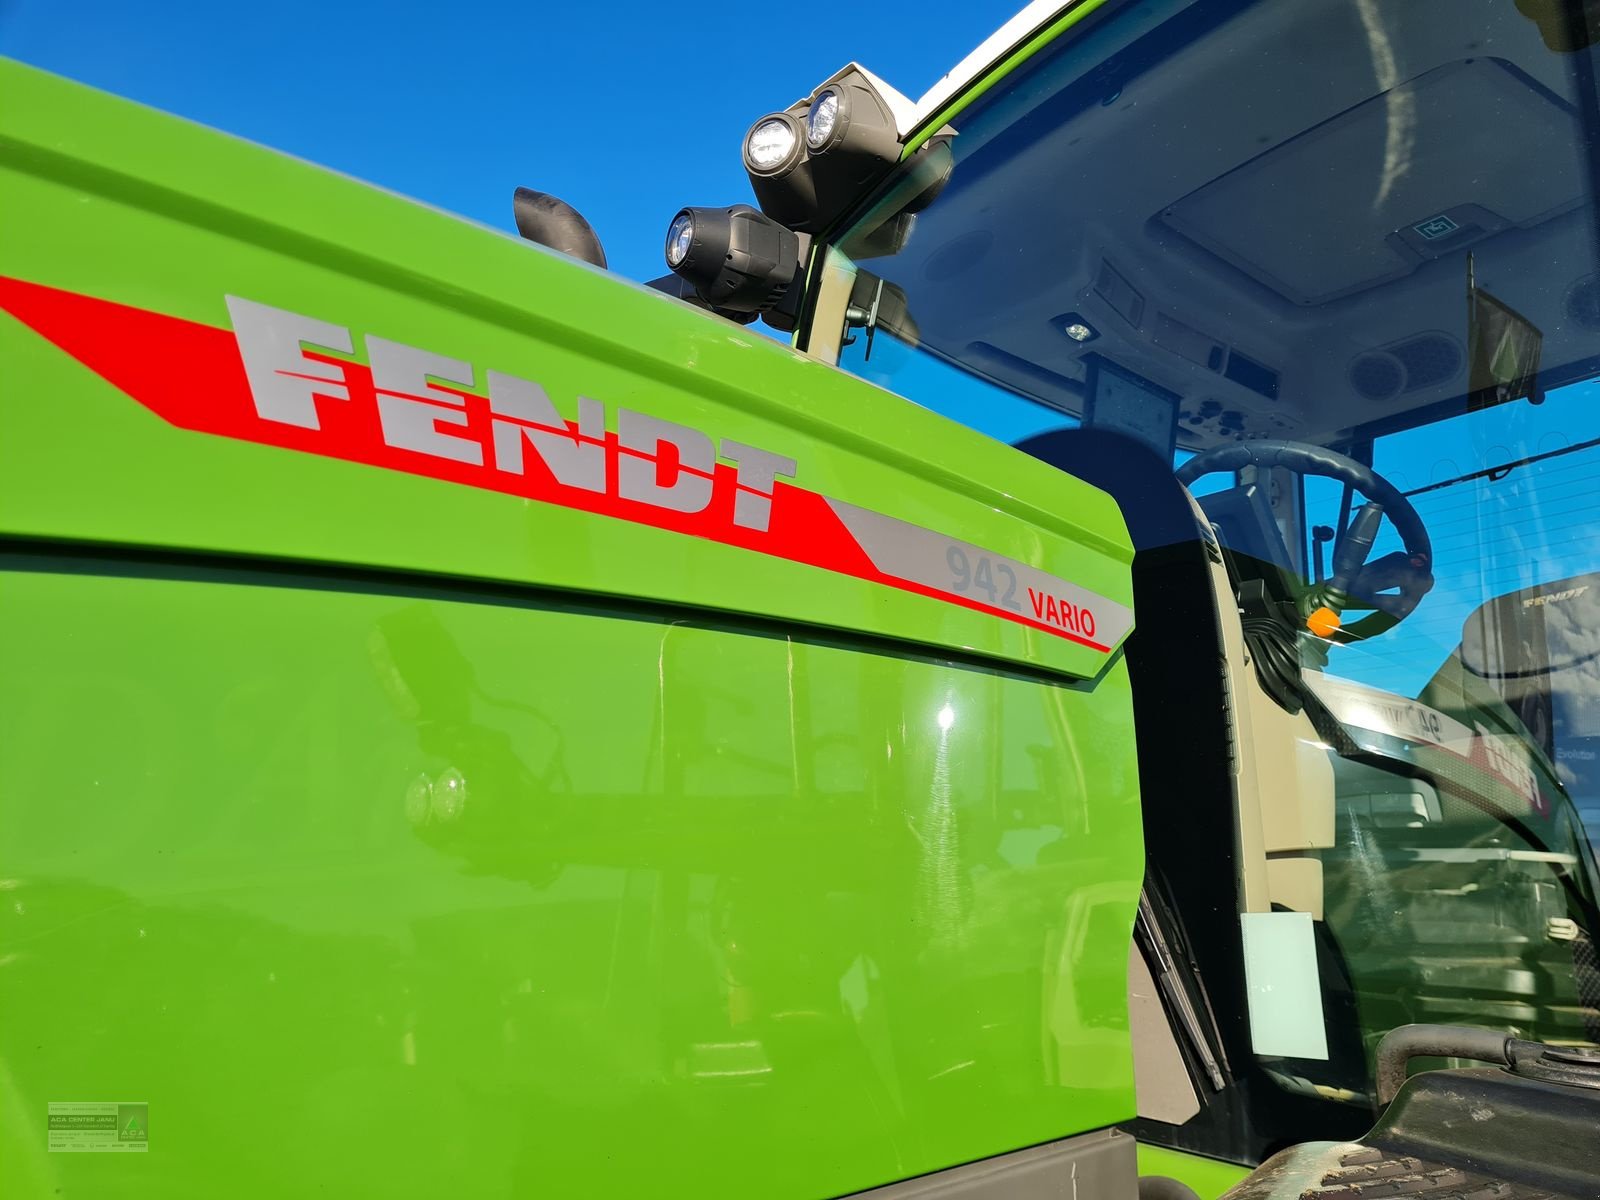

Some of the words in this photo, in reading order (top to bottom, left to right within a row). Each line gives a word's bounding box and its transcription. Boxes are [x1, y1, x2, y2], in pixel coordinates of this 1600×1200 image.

[224, 294, 797, 532] FENDT
[945, 546, 1022, 612] 942
[1028, 587, 1096, 638] VARIO
[1523, 585, 1590, 608] FENDT
